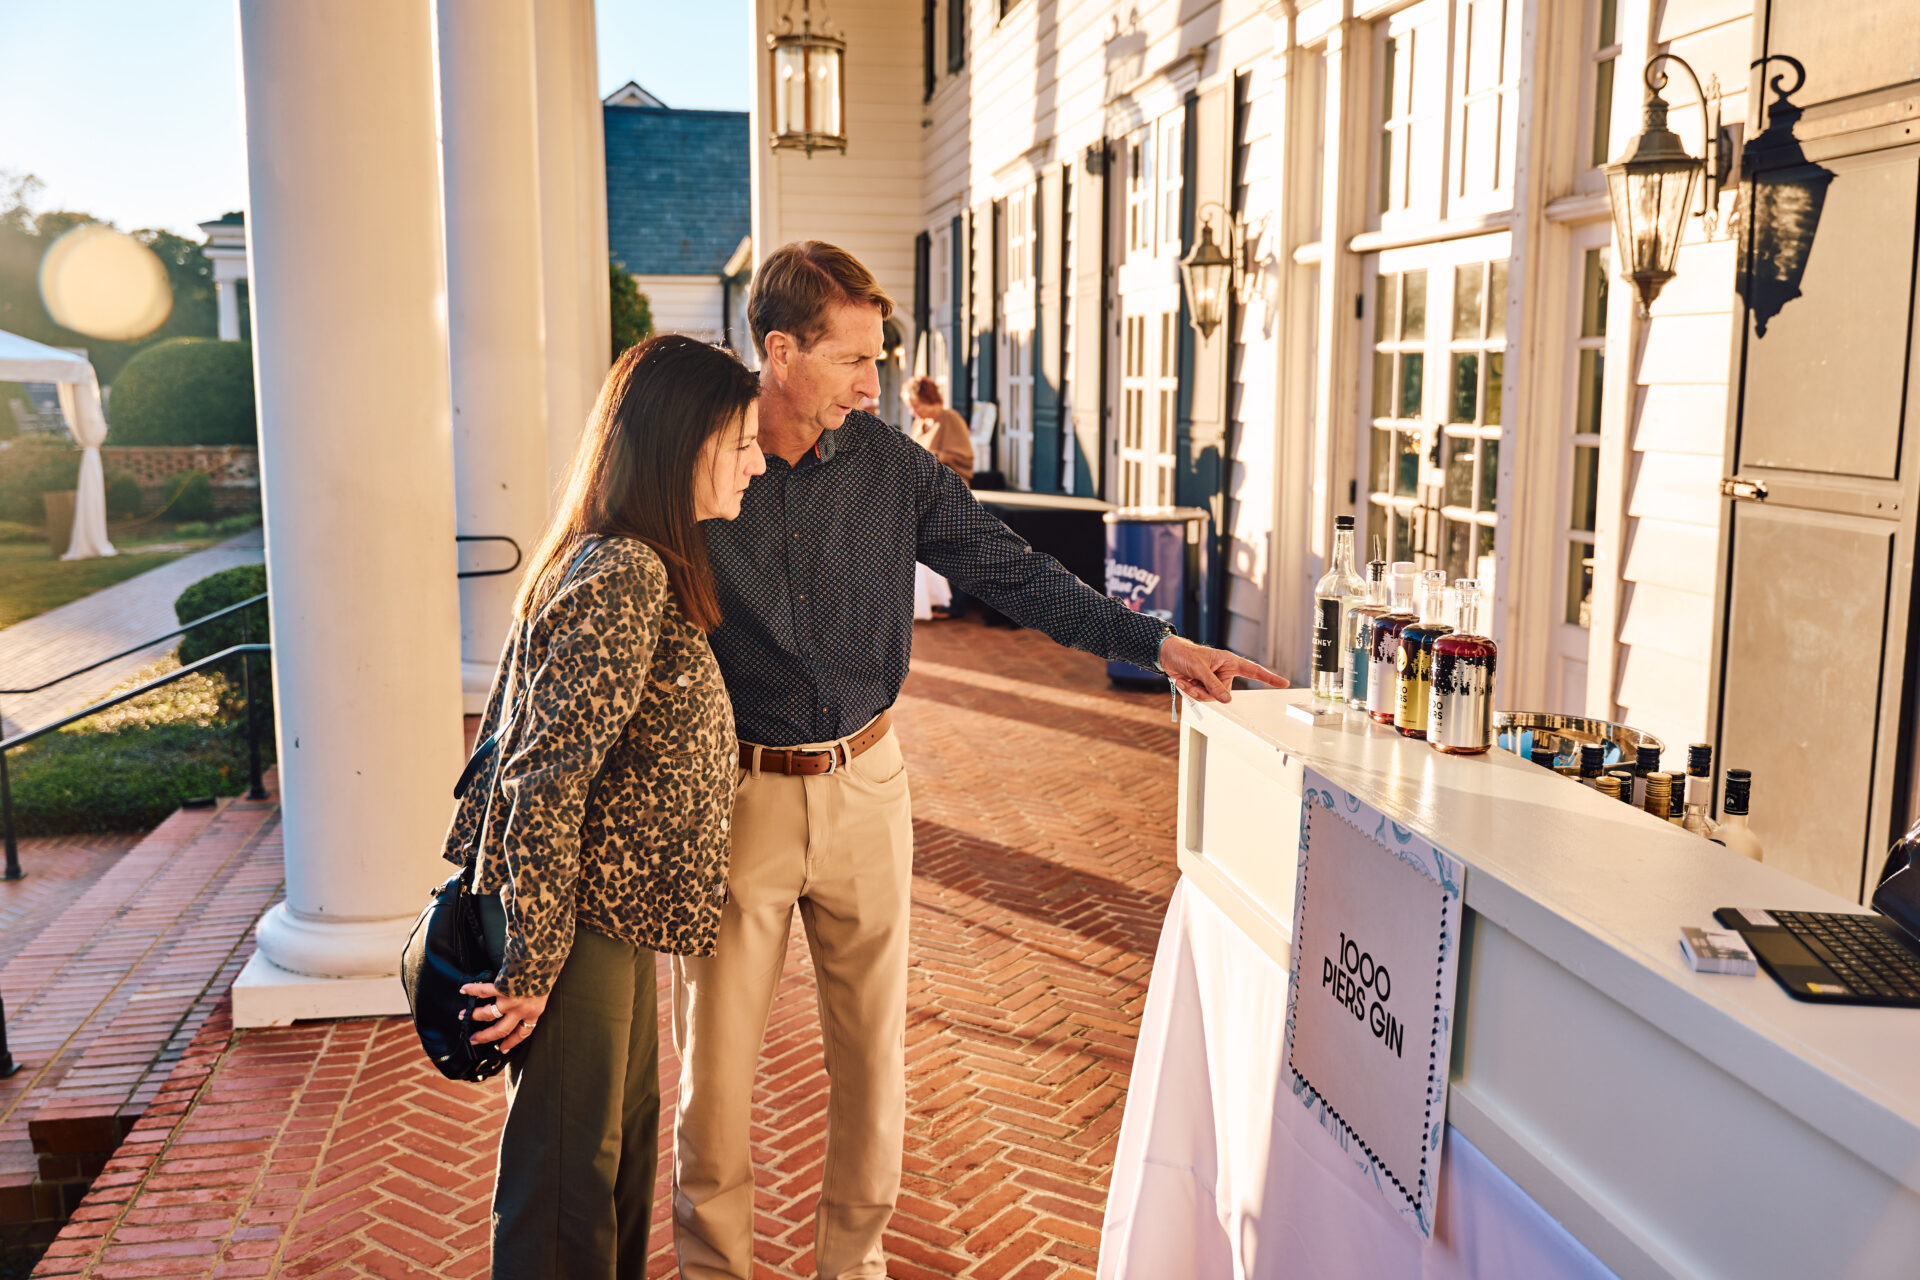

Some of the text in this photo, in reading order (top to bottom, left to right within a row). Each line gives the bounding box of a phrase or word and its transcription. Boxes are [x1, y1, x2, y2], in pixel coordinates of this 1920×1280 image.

[1322, 955, 1404, 1059] PIERS GIN
[1339, 931, 1391, 1002] 1000
